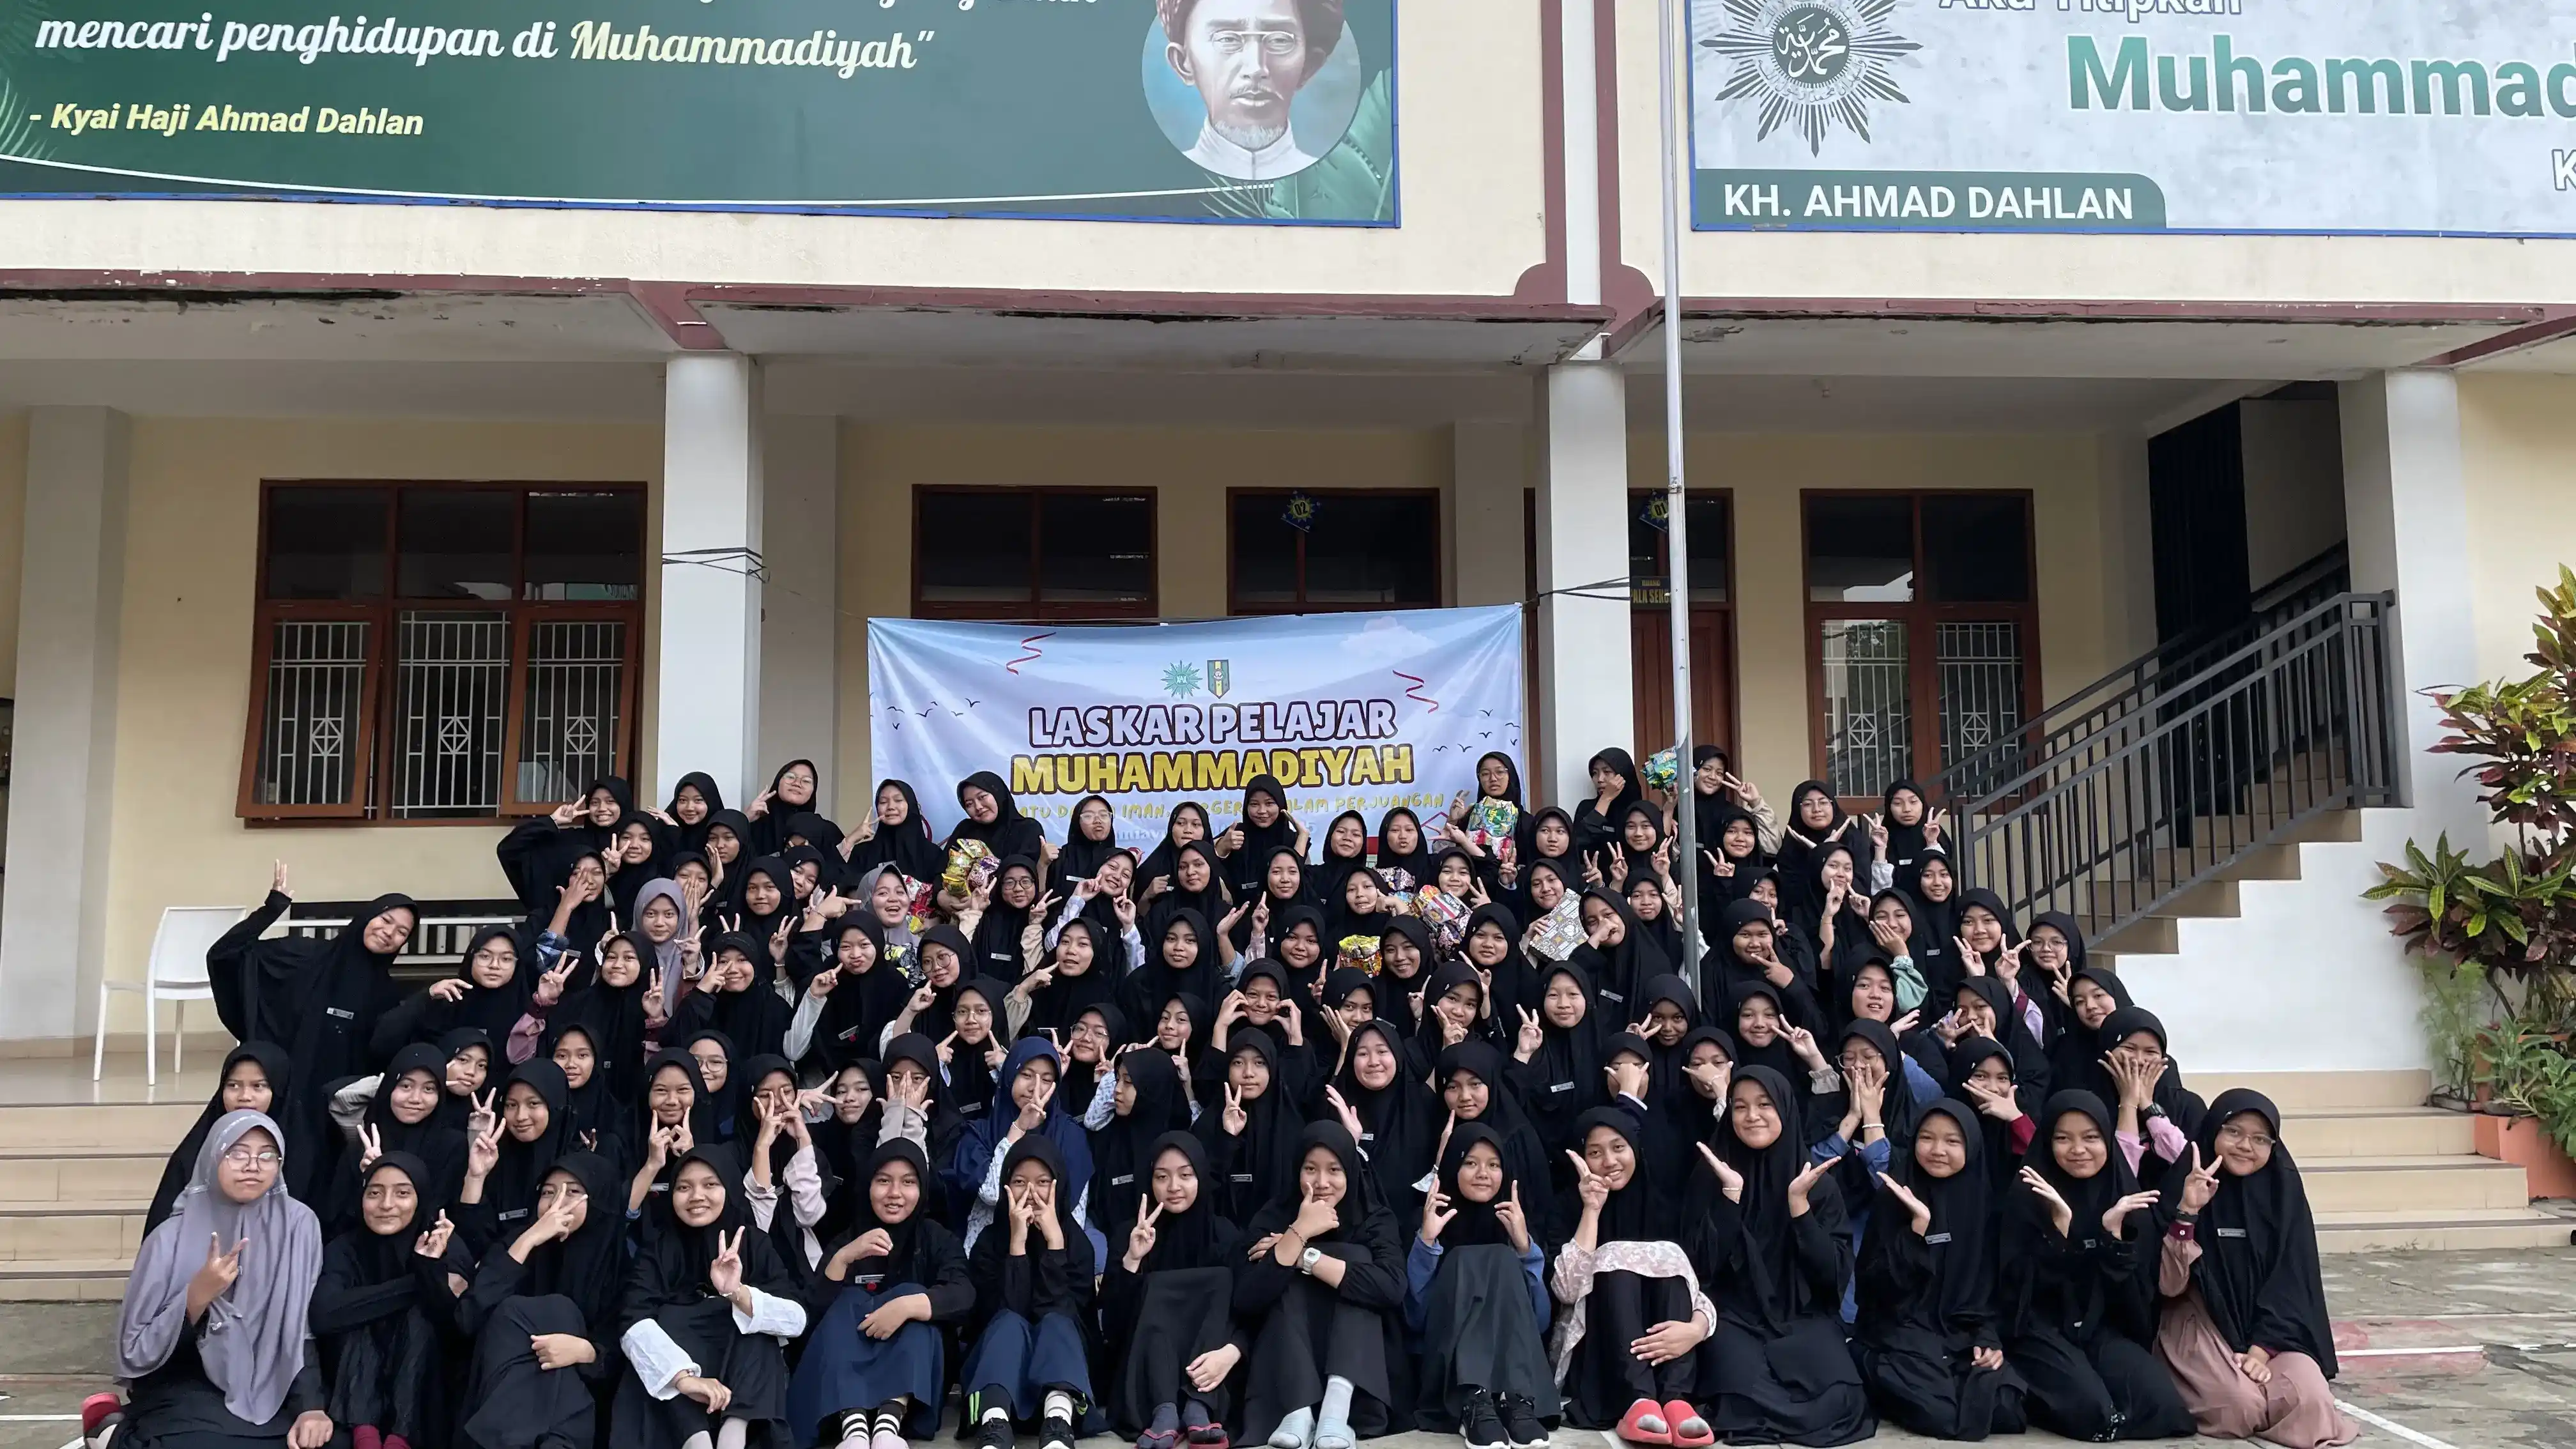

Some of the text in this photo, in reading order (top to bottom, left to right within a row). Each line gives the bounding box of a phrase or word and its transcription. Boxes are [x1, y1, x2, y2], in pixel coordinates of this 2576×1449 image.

[34, 12, 213, 49] mencari
[216, 16, 505, 66] penghidupan
[512, 20, 559, 59] di
[50, 103, 122, 136] Kyai
[126, 103, 192, 137] Haji
[195, 105, 310, 134] Ahmad
[316, 108, 424, 135] Dahlan
[1725, 183, 2134, 220] KH. AHMAD DAHLAN
[1294, 502, 1308, 516] 02
[1028, 699, 1398, 748] LASKAR PELAJAR
[1010, 743, 1414, 795] MUHAMMADIYAH
[1334, 792, 1444, 813] PERJUANGAN
